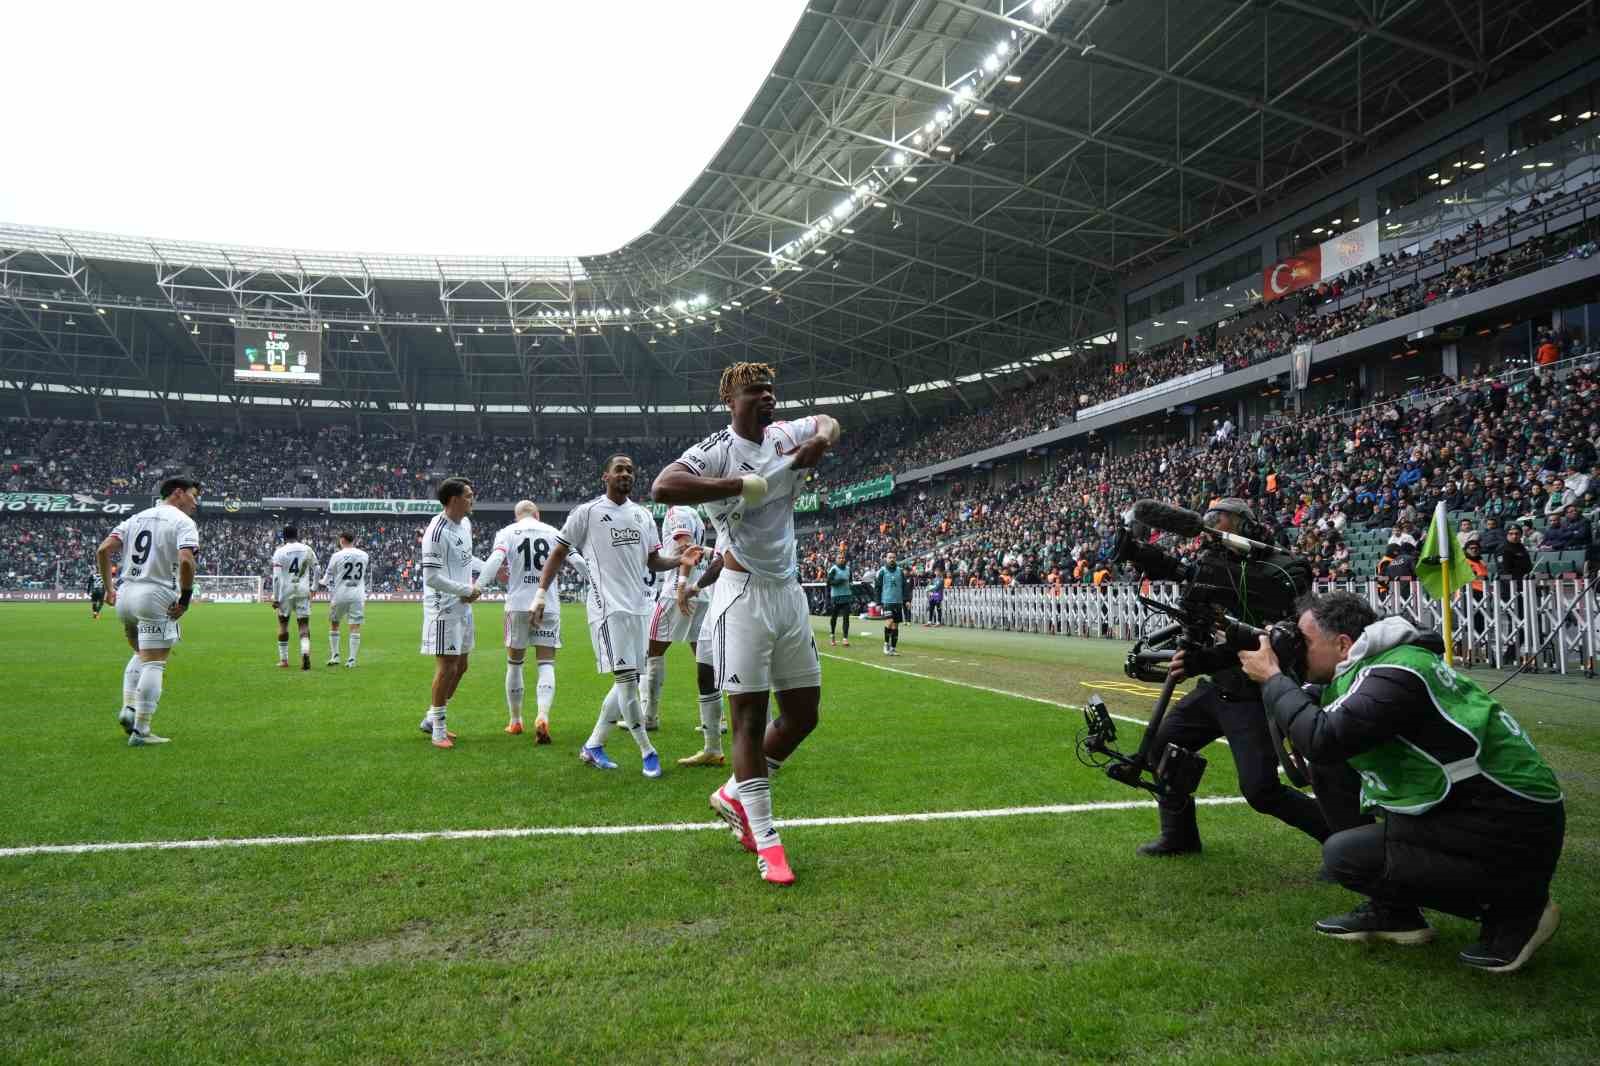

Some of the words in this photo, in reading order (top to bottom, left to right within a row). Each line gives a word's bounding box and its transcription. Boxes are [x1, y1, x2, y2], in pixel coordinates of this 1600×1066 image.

[34, 502, 96, 512] HELL
[102, 503, 135, 514] OF
[611, 528, 640, 540] beko
[132, 530, 152, 564] 9
[517, 537, 550, 572] 18
[289, 557, 300, 577] 4
[342, 562, 363, 581] 23
[524, 575, 540, 584] CERN
[57, 592, 92, 600] FOLK
